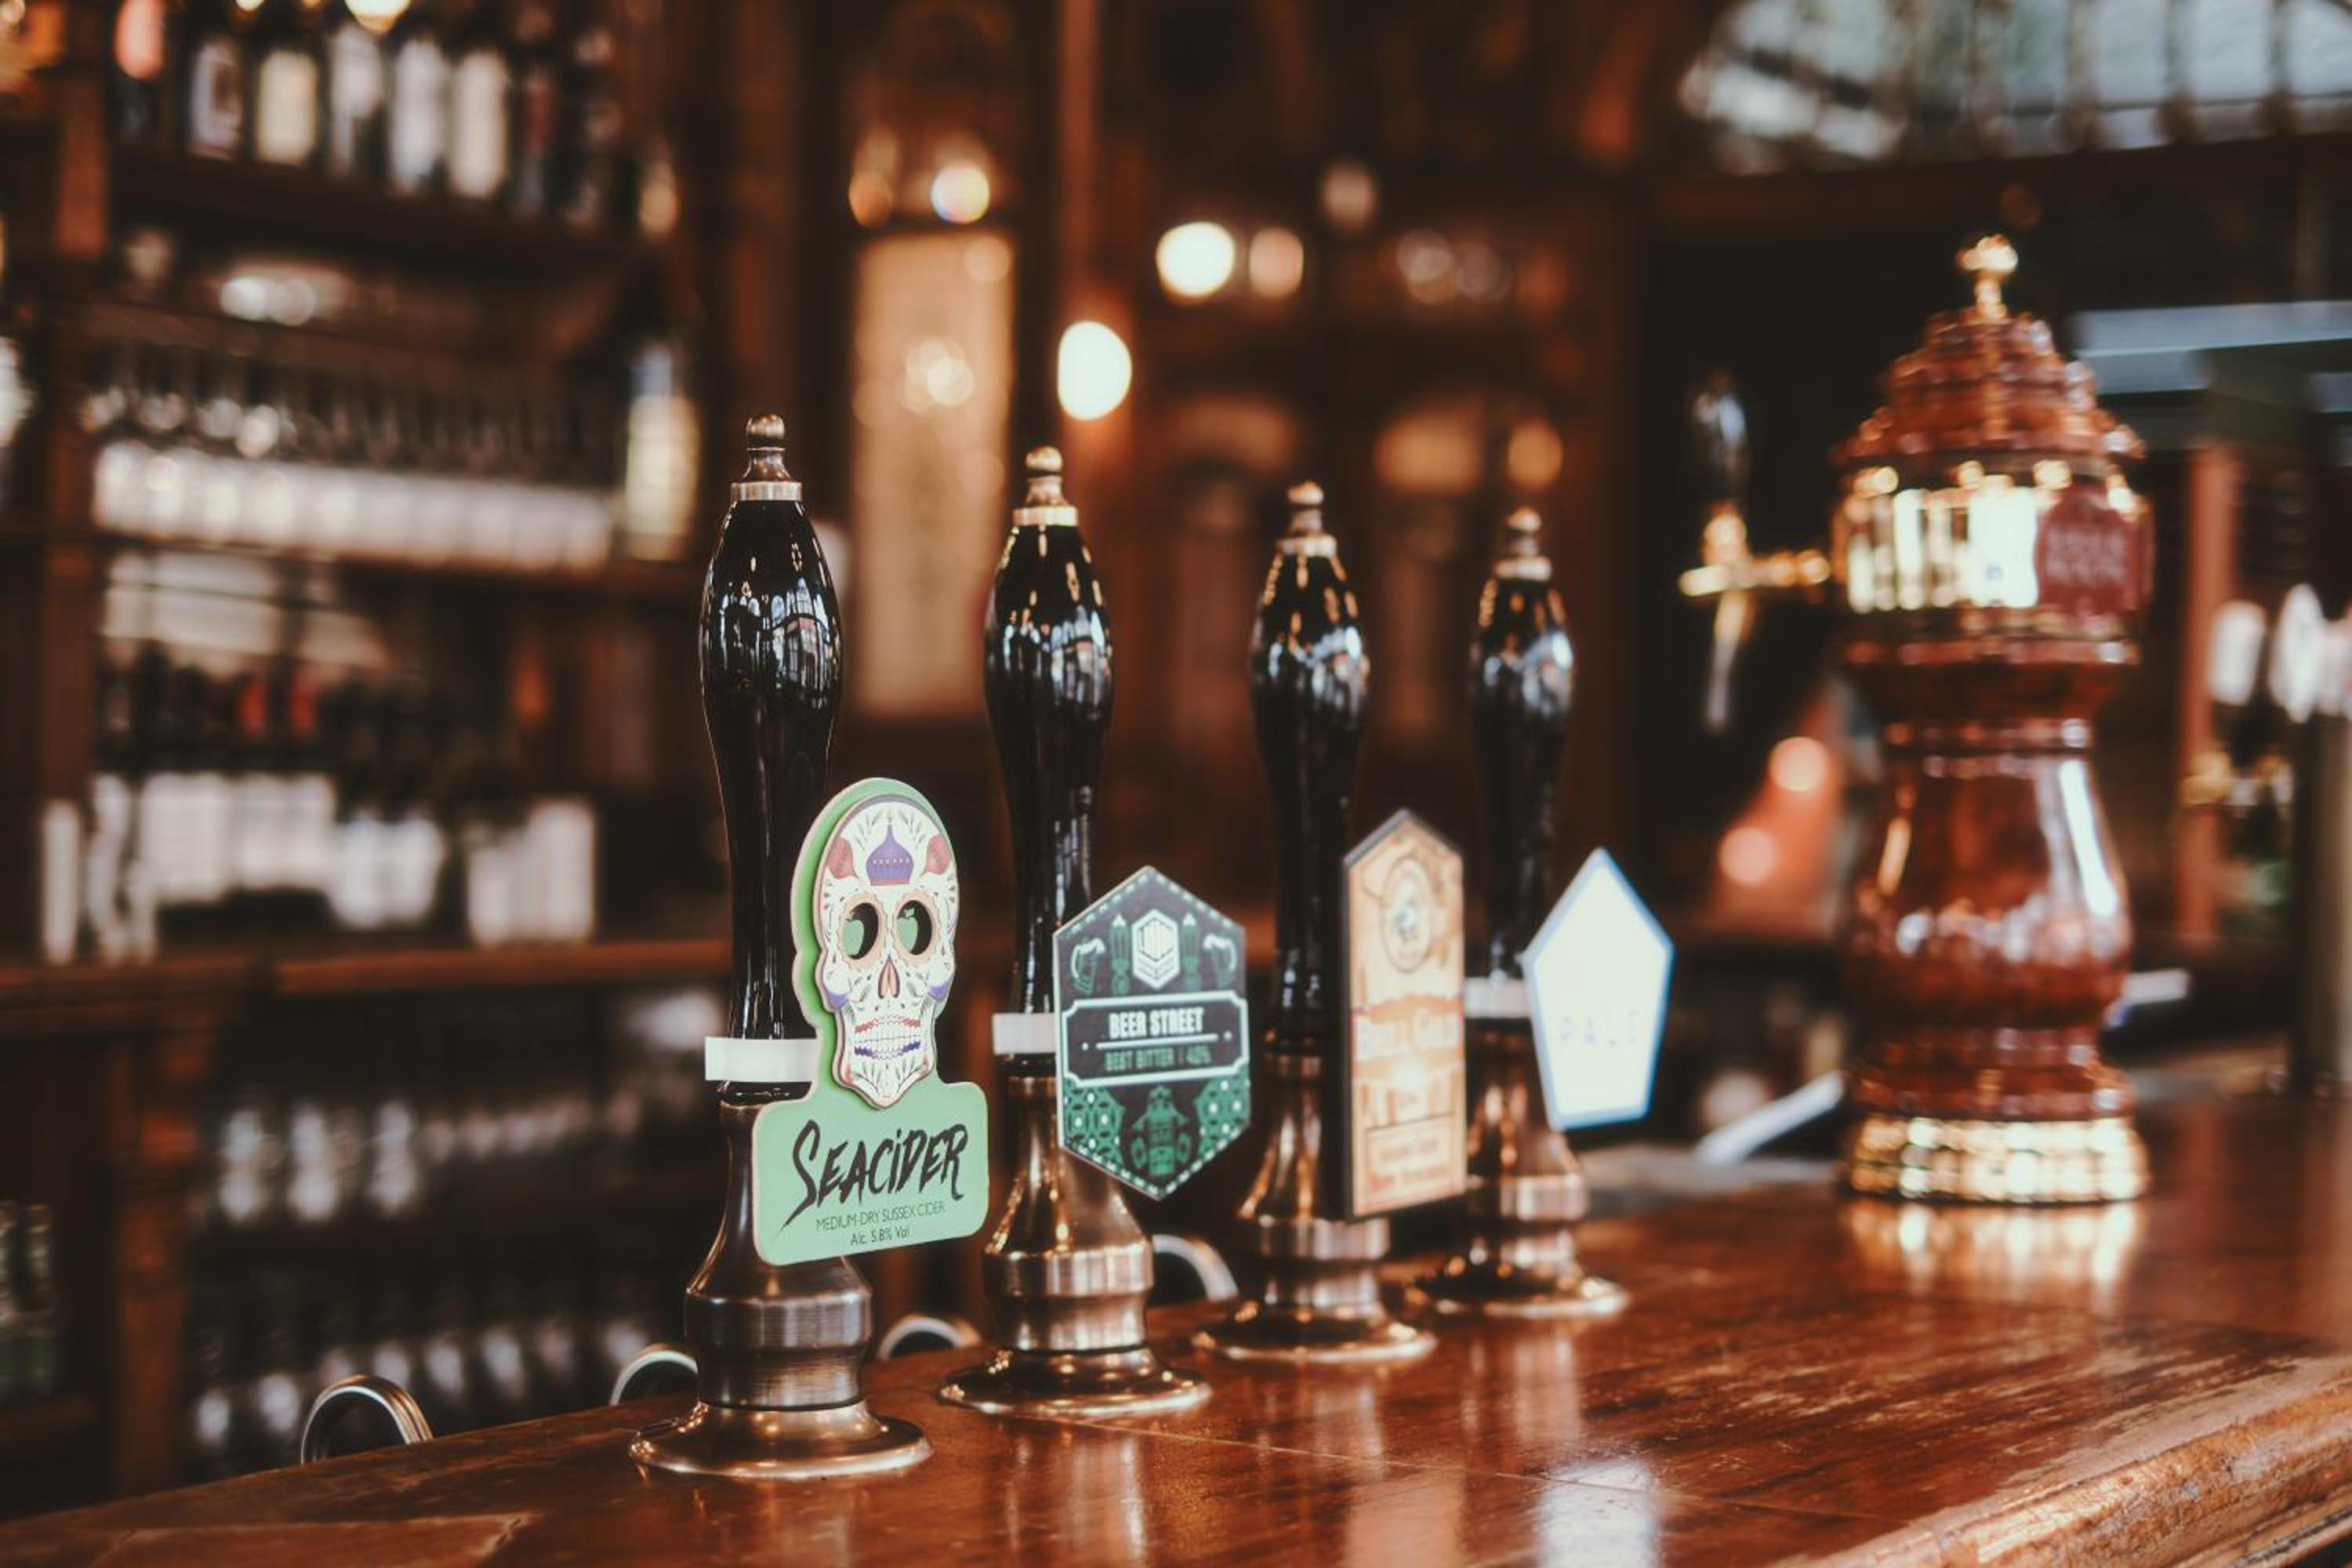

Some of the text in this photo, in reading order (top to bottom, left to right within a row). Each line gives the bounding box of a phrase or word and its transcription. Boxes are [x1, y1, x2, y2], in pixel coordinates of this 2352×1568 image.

[1109, 1007, 1204, 1040] BEER STREET
[1105, 1051, 1132, 1072] BEST
[1135, 1047, 1174, 1069] BITTER
[816, 1200, 946, 1230] MEDIUM-DRY SUSSEX CIDER
[871, 1228, 893, 1243] 5.8%
[895, 1225, 910, 1239] Vol
